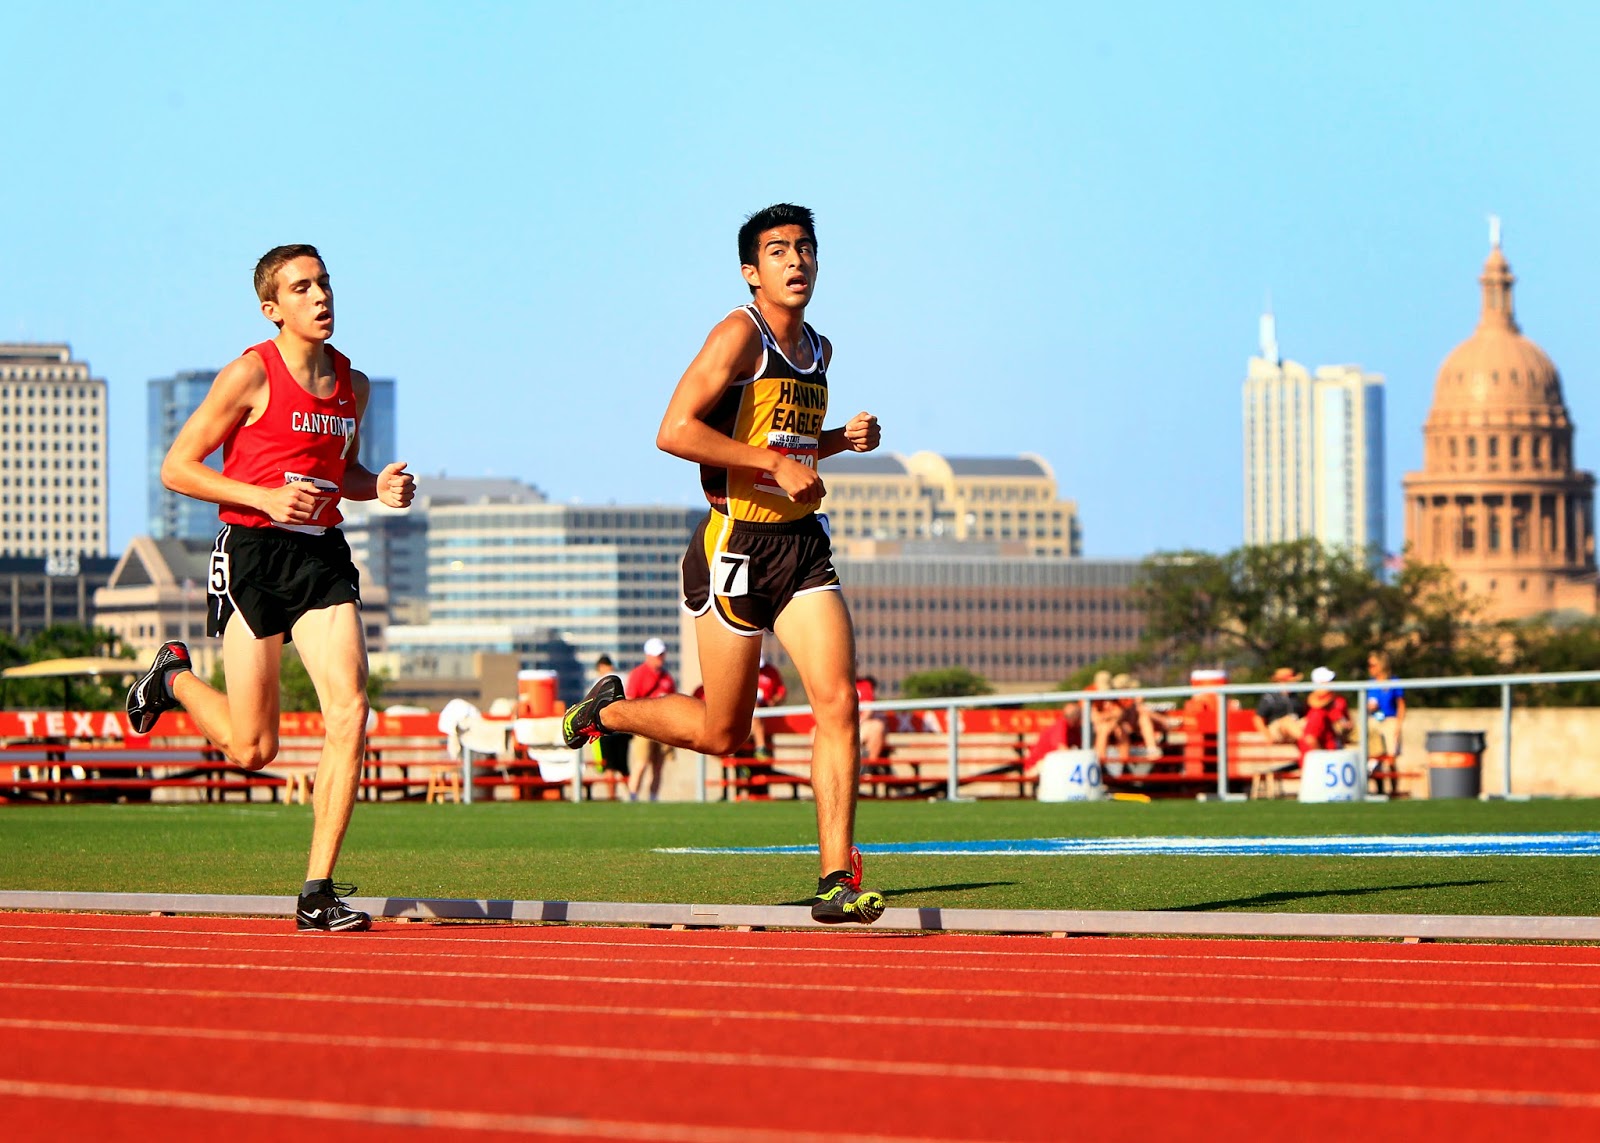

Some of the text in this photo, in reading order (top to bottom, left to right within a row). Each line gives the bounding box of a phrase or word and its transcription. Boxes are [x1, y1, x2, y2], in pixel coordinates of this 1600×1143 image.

[779, 381, 825, 410] HANNA
[292, 411, 345, 436] CANYON
[212, 556, 226, 592] 5
[720, 556, 744, 593] 7
[18, 712, 148, 737] TEXA
[1069, 764, 1101, 787] 40
[1325, 763, 1356, 788] 50
